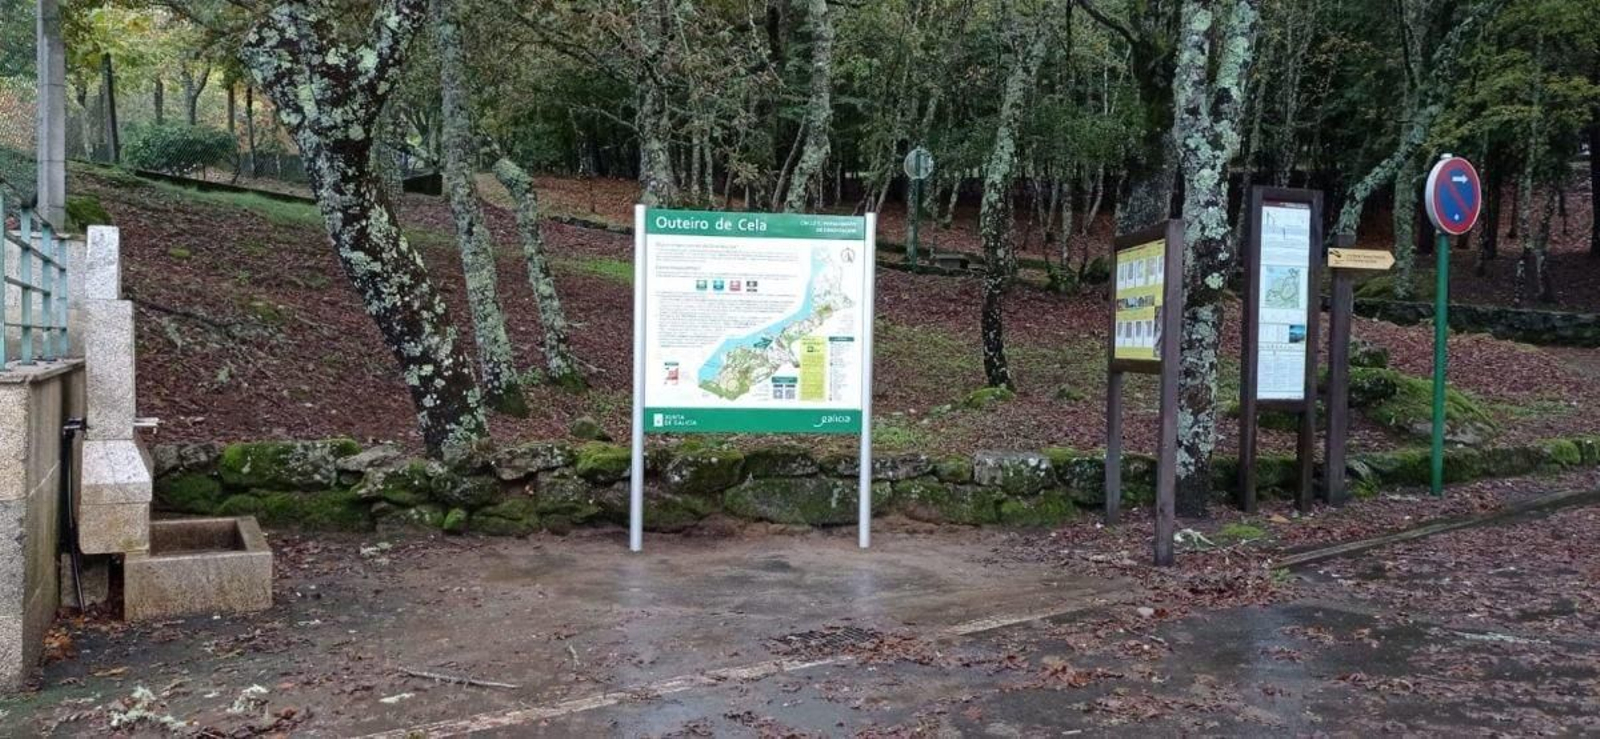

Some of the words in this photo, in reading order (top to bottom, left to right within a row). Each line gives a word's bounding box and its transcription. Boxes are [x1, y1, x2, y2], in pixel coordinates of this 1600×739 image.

[655, 215, 709, 229] Outeiro
[715, 216, 732, 230] de
[737, 218, 767, 232] Cela
